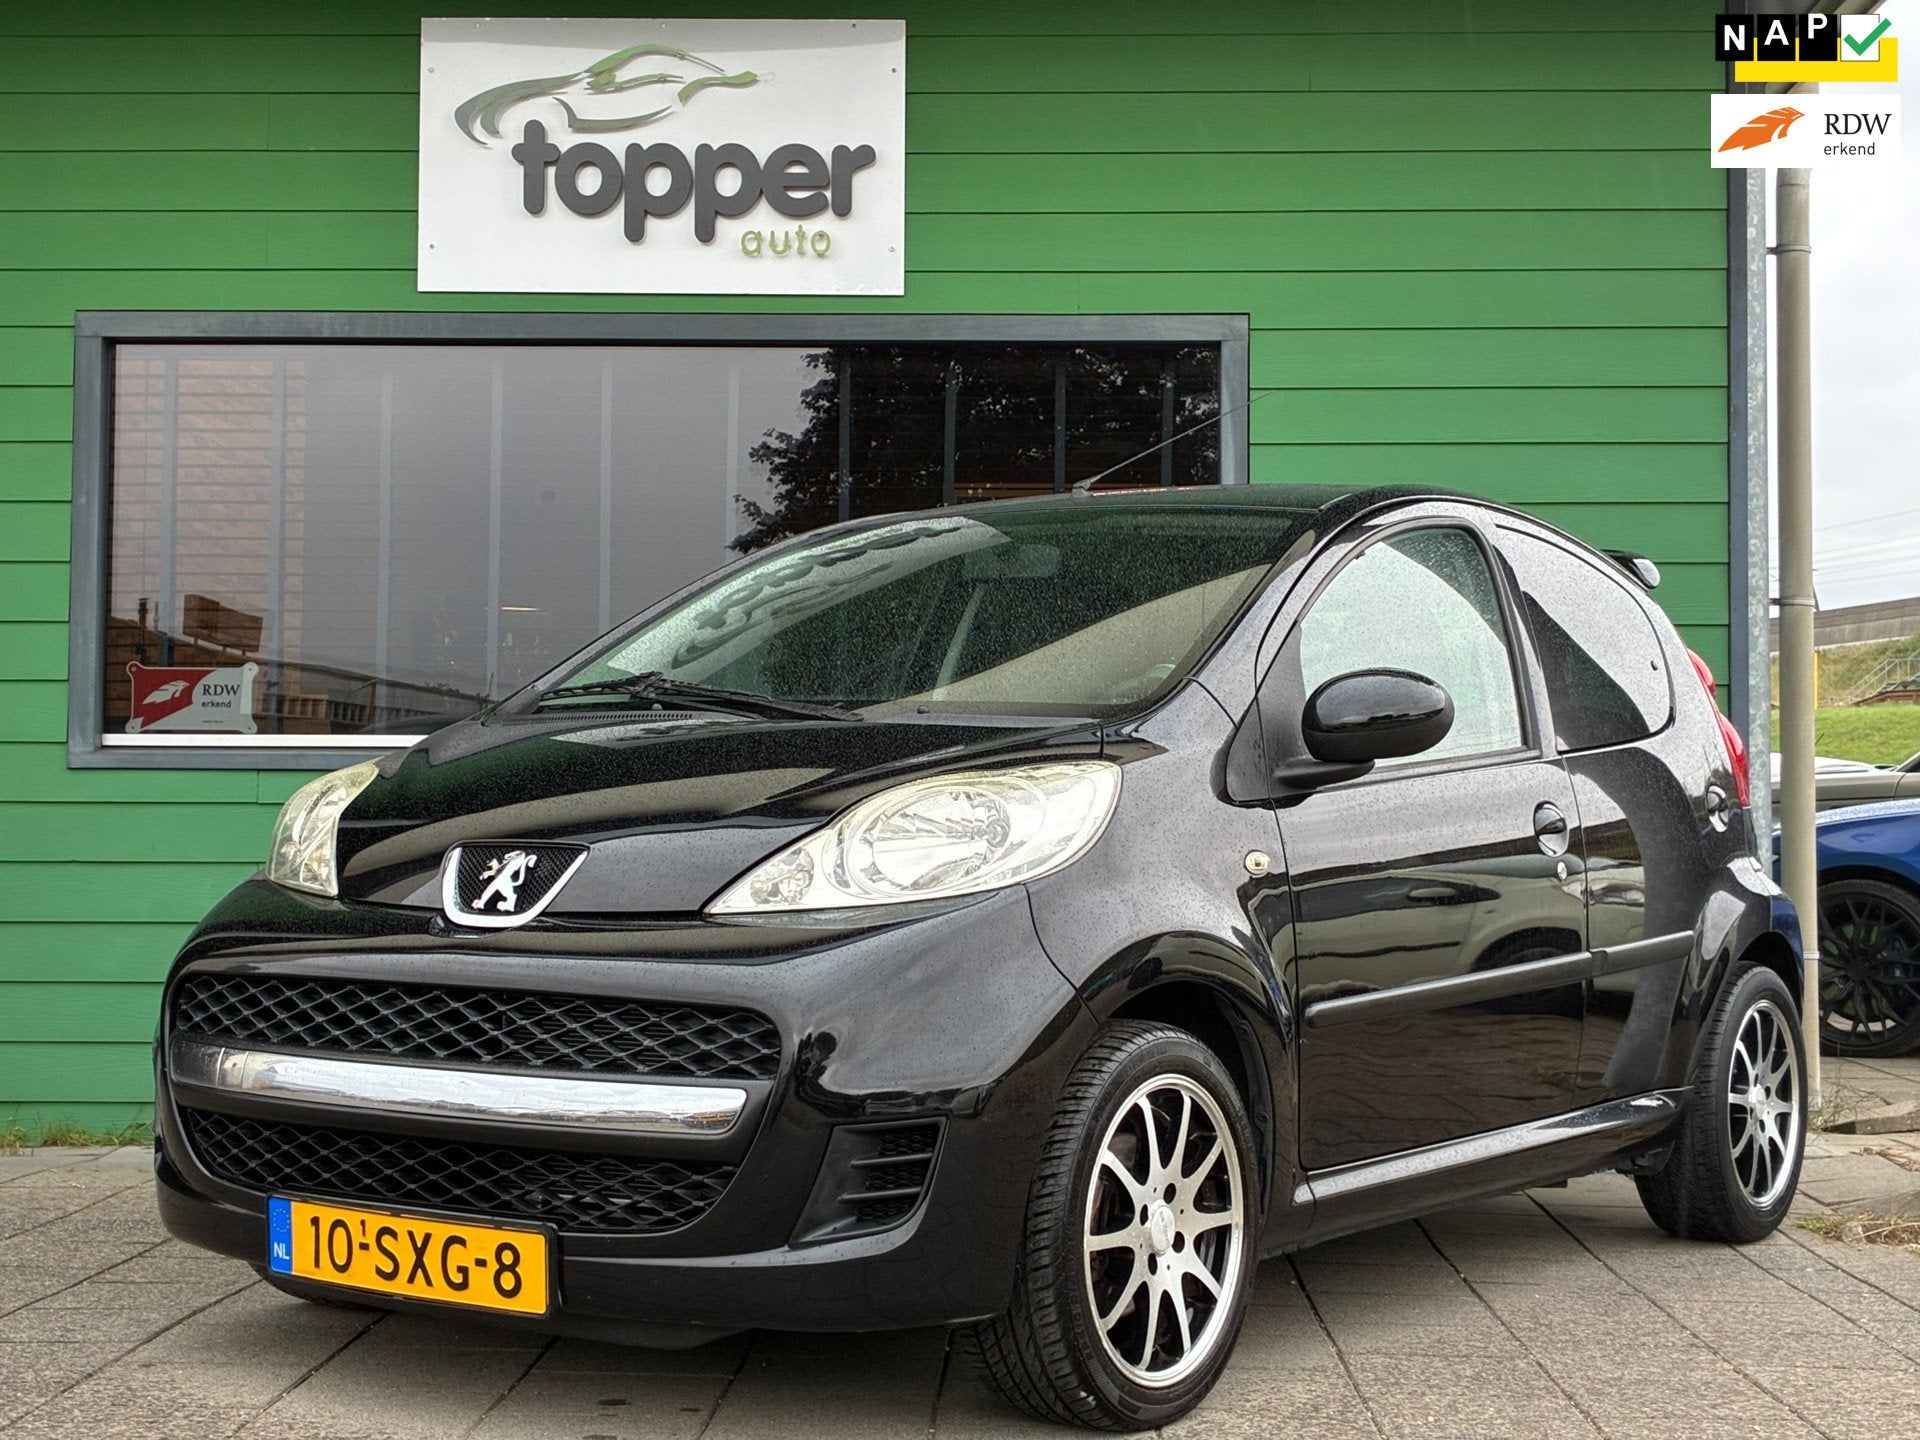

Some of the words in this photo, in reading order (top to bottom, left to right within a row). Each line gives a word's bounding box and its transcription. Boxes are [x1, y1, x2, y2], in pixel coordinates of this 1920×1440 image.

[511, 119, 876, 243] topper
[741, 224, 831, 258] auto
[202, 684, 240, 696] RDW
[201, 700, 232, 708] erkend
[273, 1241, 290, 1261] NL
